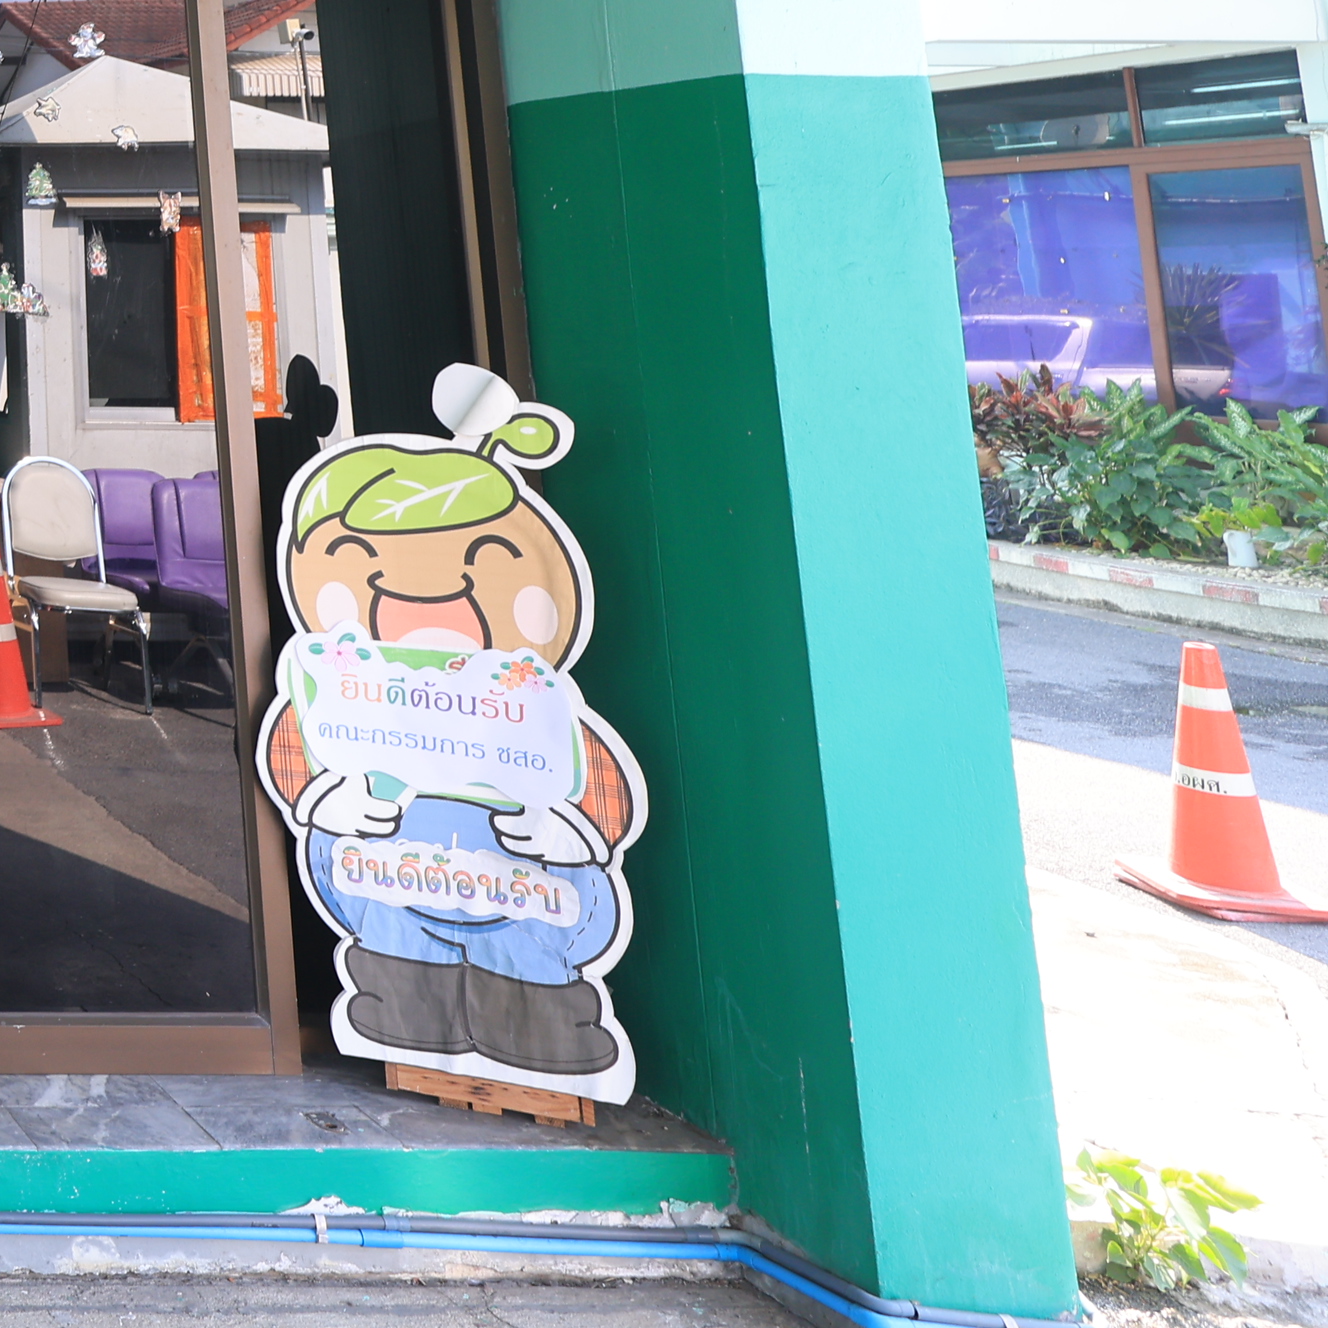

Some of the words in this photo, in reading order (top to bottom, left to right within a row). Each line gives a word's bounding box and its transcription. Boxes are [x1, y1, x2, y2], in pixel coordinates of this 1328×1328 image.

[339, 672, 526, 723] ยินดีต้อนรับ
[317, 720, 486, 759] คณะกรรมการ
[496, 745, 554, 773] ชสอ.
[340, 845, 563, 916] ยินดีต้อนรับ
